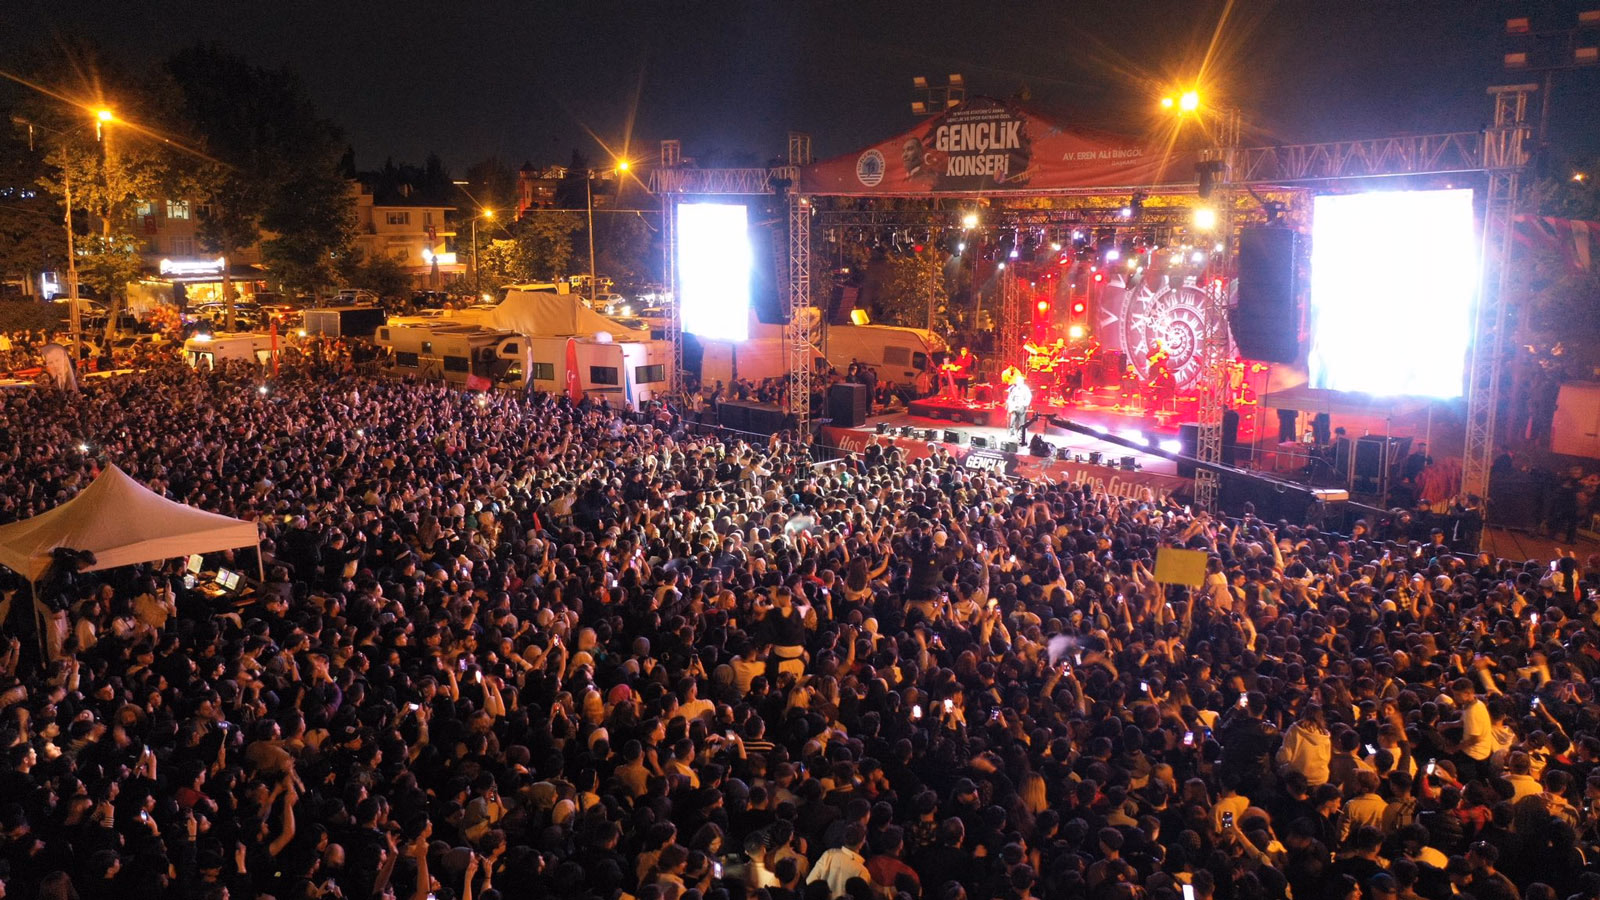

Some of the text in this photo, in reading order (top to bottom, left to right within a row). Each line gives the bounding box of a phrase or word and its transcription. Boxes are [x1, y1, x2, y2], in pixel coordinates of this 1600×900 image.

[936, 121, 1021, 154] GENÇLİK
[946, 154, 1009, 177] KONSERİ
[1062, 152, 1076, 161] AV.
[1077, 151, 1096, 160] EREN
